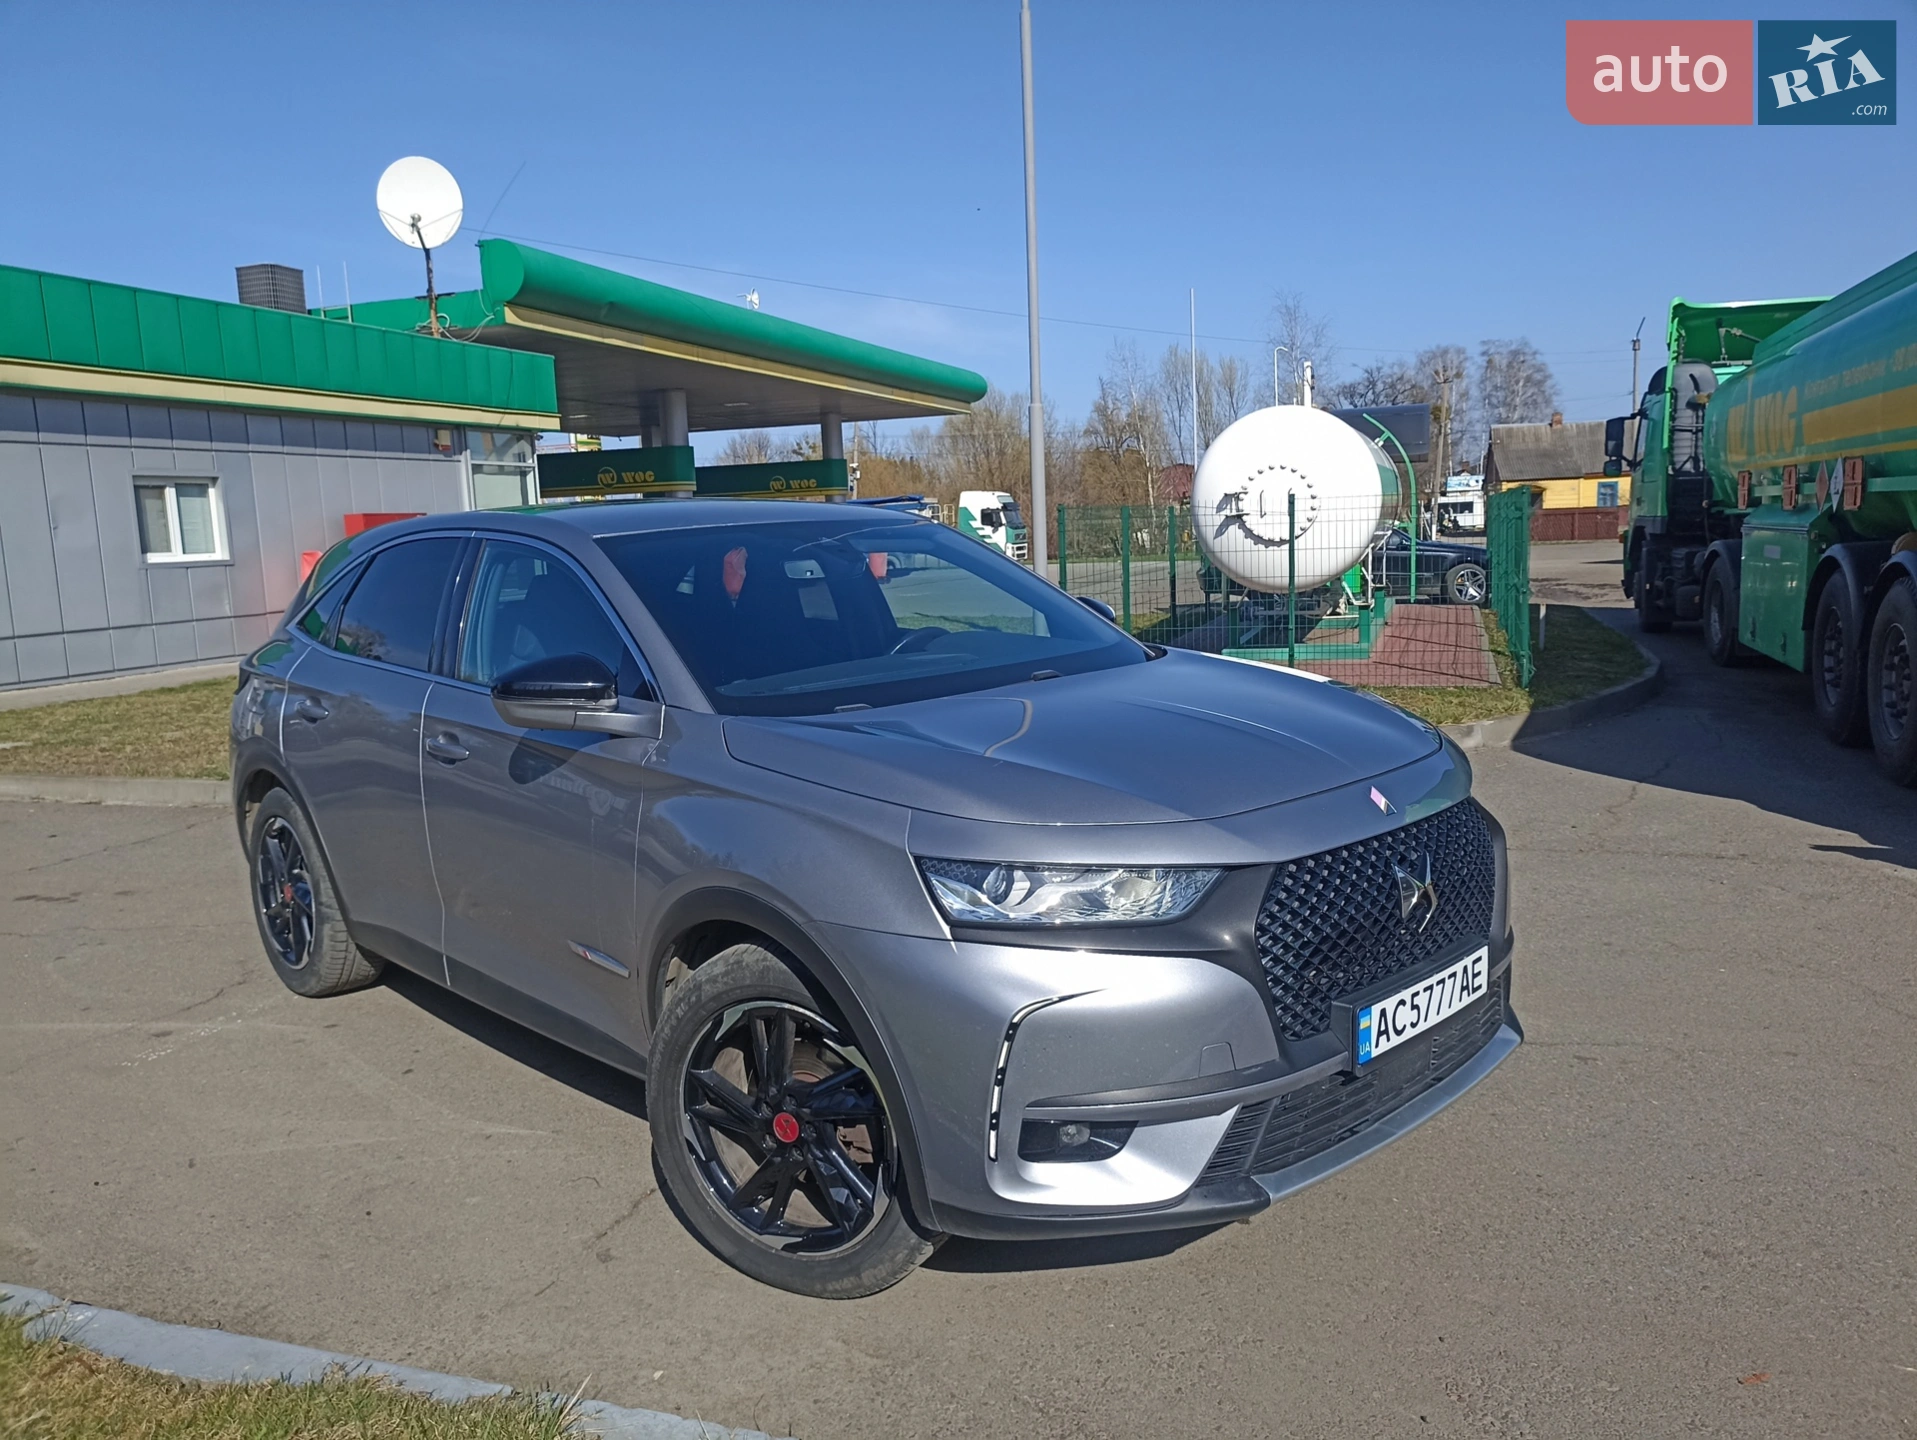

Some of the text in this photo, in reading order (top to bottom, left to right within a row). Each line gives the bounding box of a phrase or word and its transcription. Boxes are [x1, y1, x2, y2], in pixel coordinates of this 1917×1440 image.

[621, 471, 655, 483] WOG
[1375, 955, 1484, 1049] AC5777AE
[1359, 1042, 1371, 1055] UA
